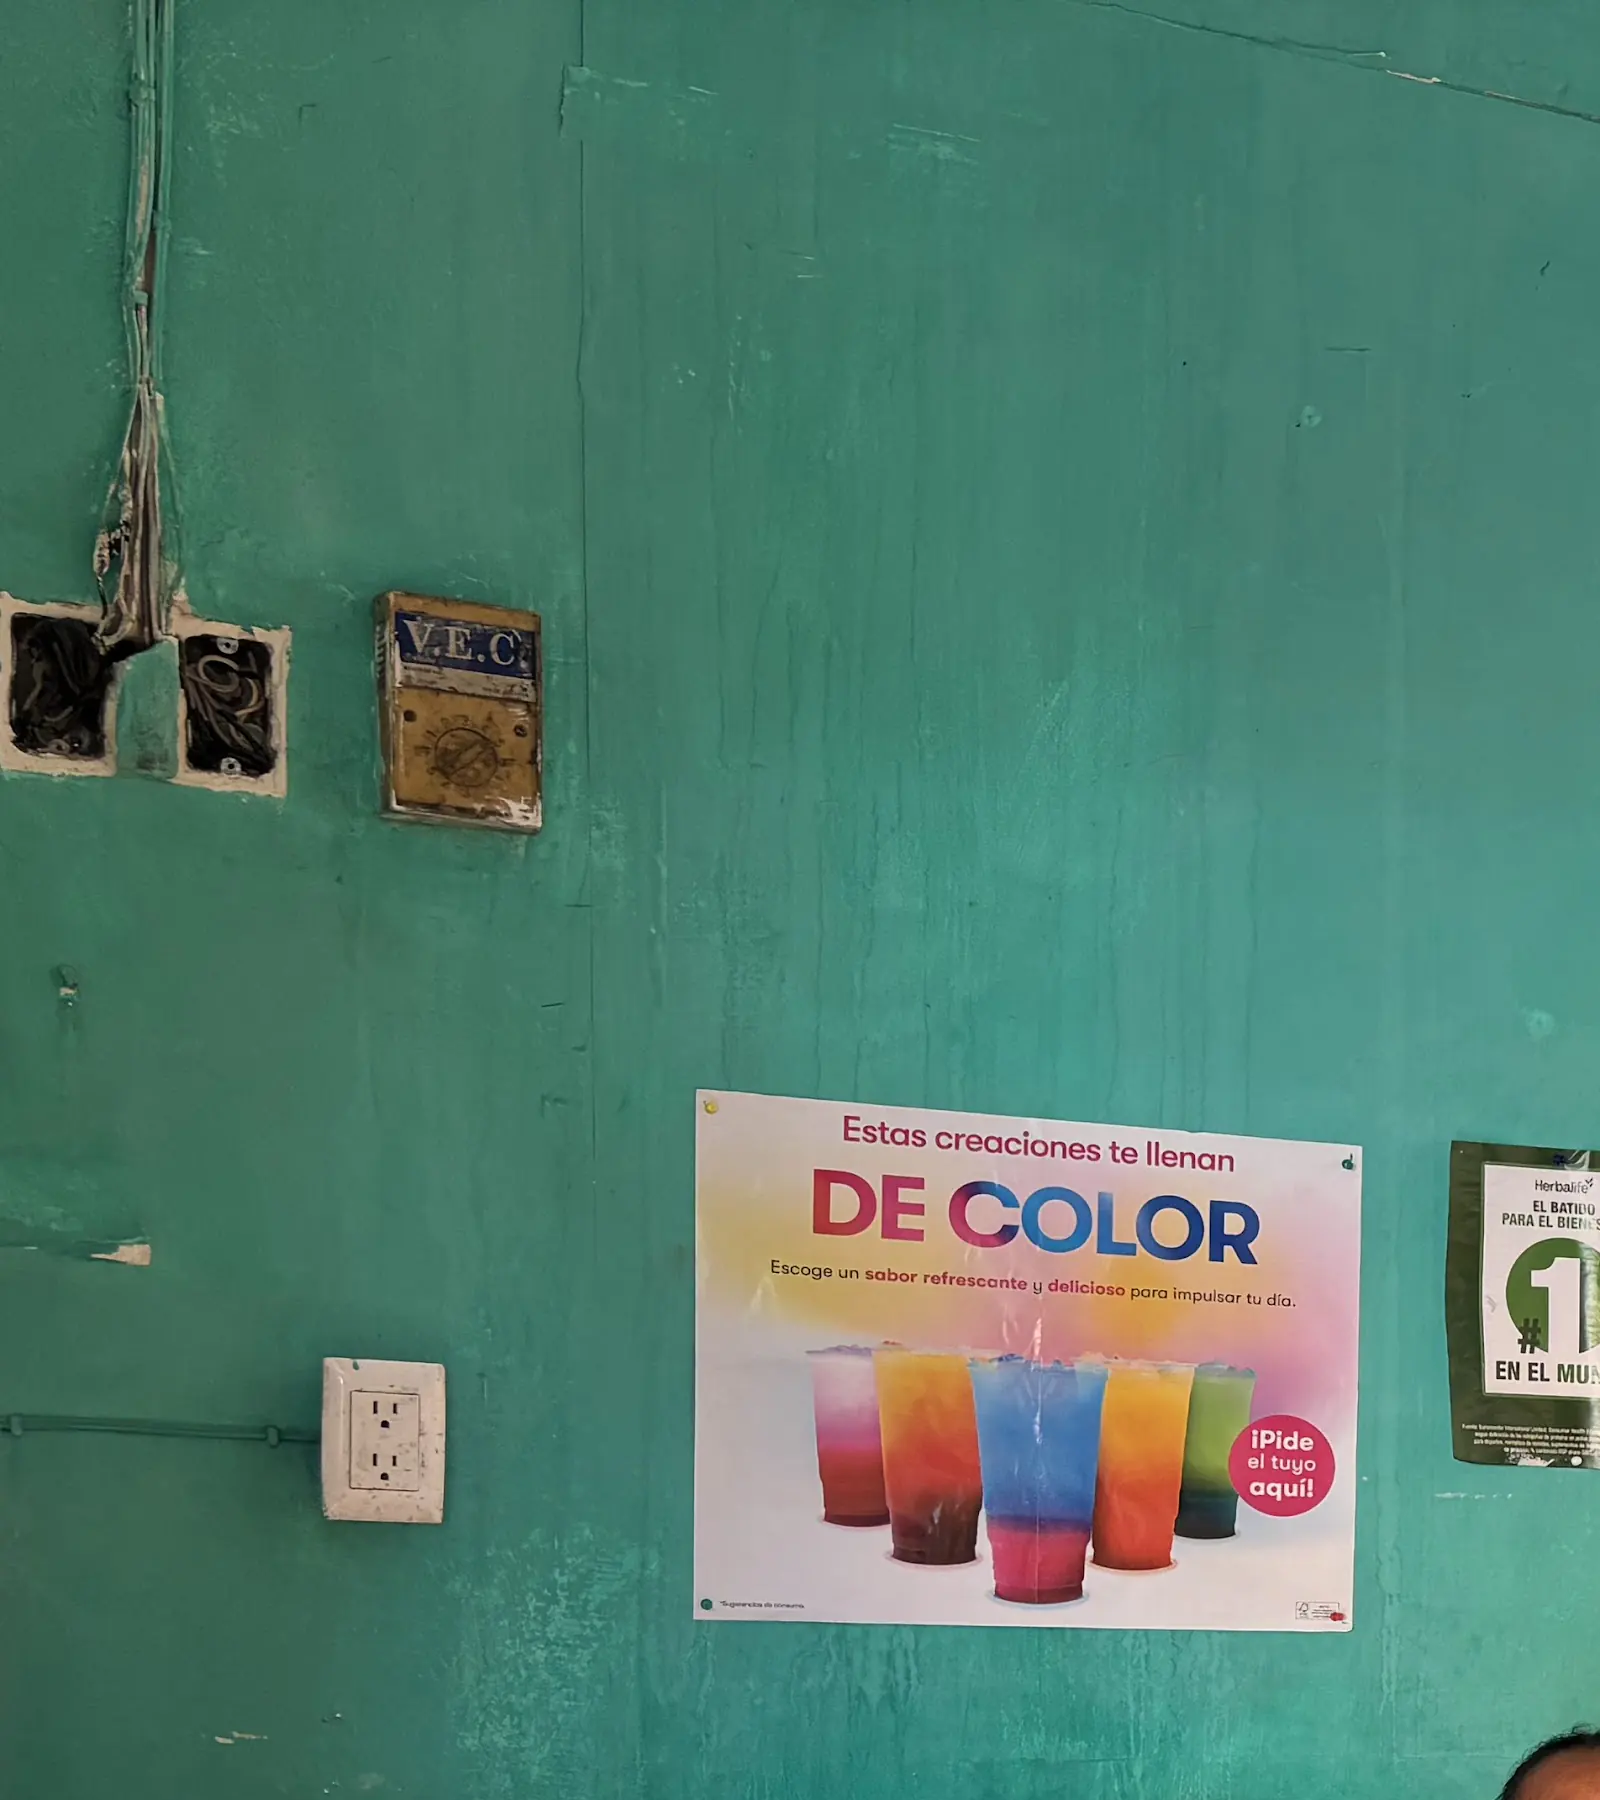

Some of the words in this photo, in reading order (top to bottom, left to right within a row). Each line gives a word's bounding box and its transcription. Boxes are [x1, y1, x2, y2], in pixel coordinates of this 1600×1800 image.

[843, 1115, 926, 1150] Estas
[935, 1128, 1101, 1163] creaciones
[1108, 1139, 1139, 1166] te
[1145, 1140, 1235, 1174] llenan
[1535, 1180, 1589, 1195] Herbalife
[812, 1168, 926, 1243] DE
[948, 1181, 1260, 1266] COLOR
[1533, 1200, 1547, 1214] EL
[1550, 1201, 1596, 1217] BATIDO
[1502, 1213, 1535, 1228] PARA
[1538, 1215, 1554, 1228] EL
[769, 1259, 834, 1282] Escoge
[837, 1266, 860, 1280] un
[864, 1266, 918, 1284] sabor
[922, 1269, 1028, 1291] refrescante
[1031, 1281, 1044, 1295] y
[1047, 1278, 1126, 1298] delicioso
[1129, 1288, 1168, 1302] para
[1172, 1287, 1243, 1306] impulsar
[1246, 1293, 1263, 1305] tu
[1265, 1291, 1297, 1308] día.
[1496, 1360, 1521, 1382] EN
[1527, 1361, 1550, 1383] EL
[1250, 1429, 1315, 1452] ¡Pide
[1247, 1455, 1265, 1470] el
[1269, 1456, 1317, 1476] tuyo
[1248, 1477, 1315, 1501] aquí!
